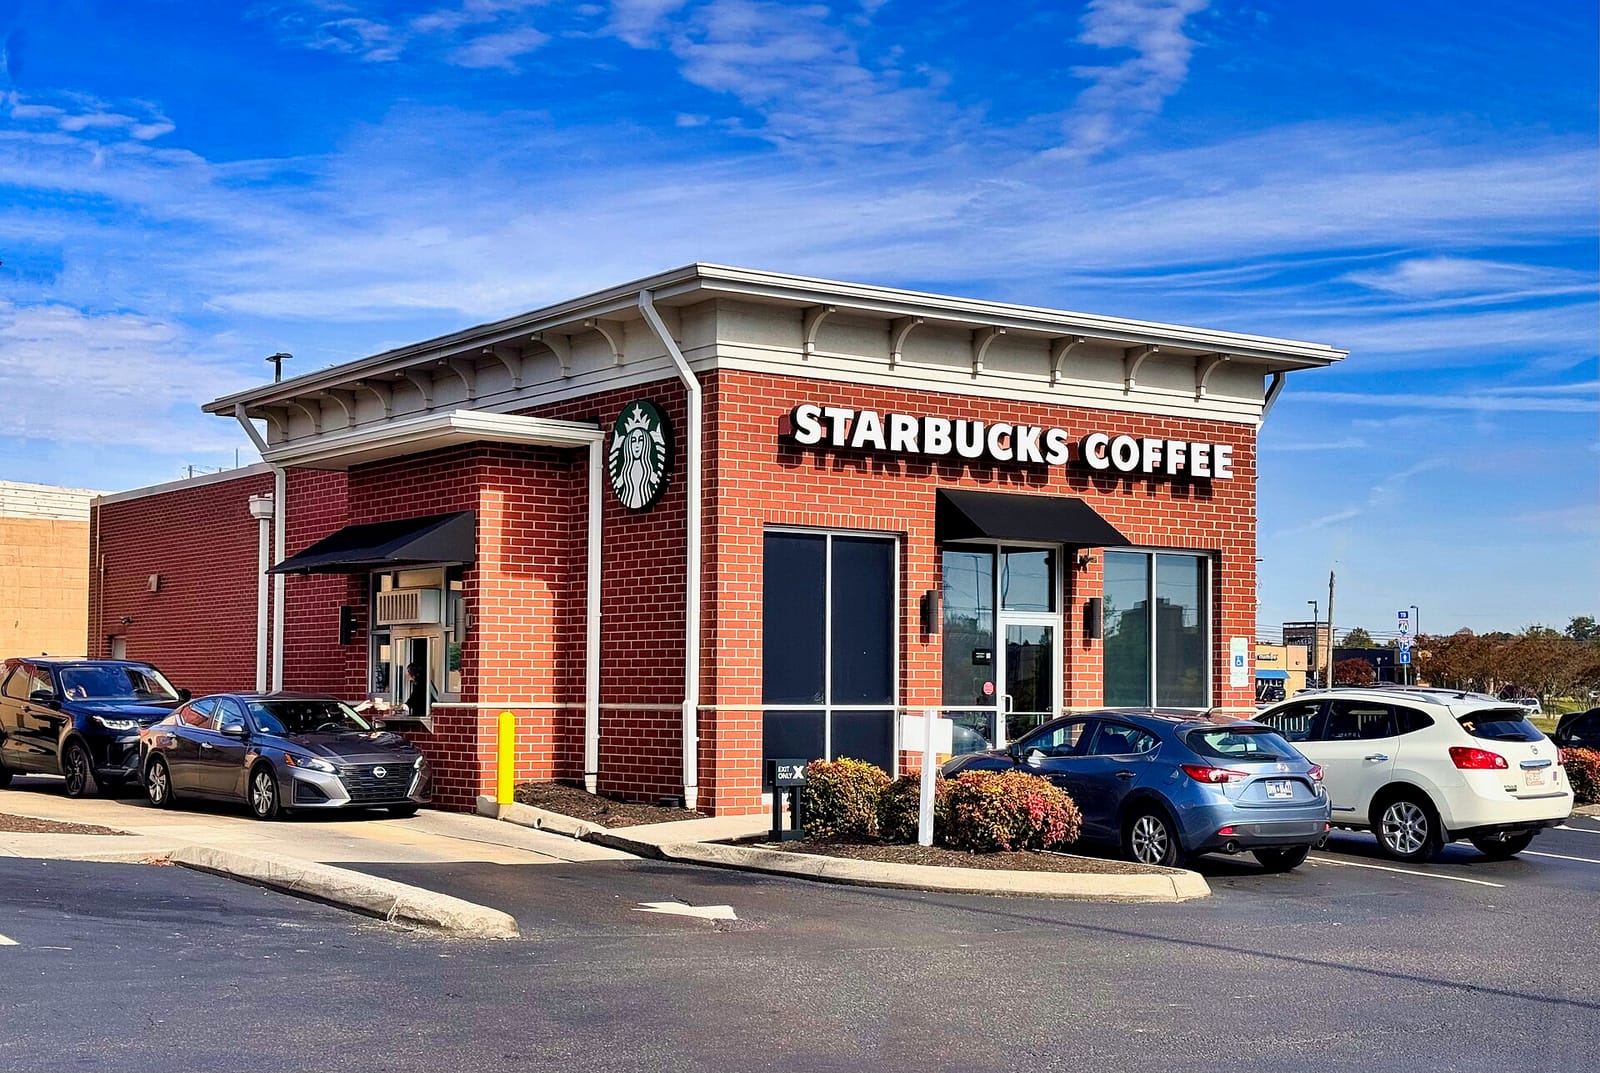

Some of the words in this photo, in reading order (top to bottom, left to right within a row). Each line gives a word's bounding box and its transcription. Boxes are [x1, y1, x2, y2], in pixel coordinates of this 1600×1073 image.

[794, 404, 1069, 465] STARBUCKS
[1085, 432, 1234, 479] COFFEE
[1400, 623, 1408, 632] 40
[1400, 640, 1409, 650] 75
